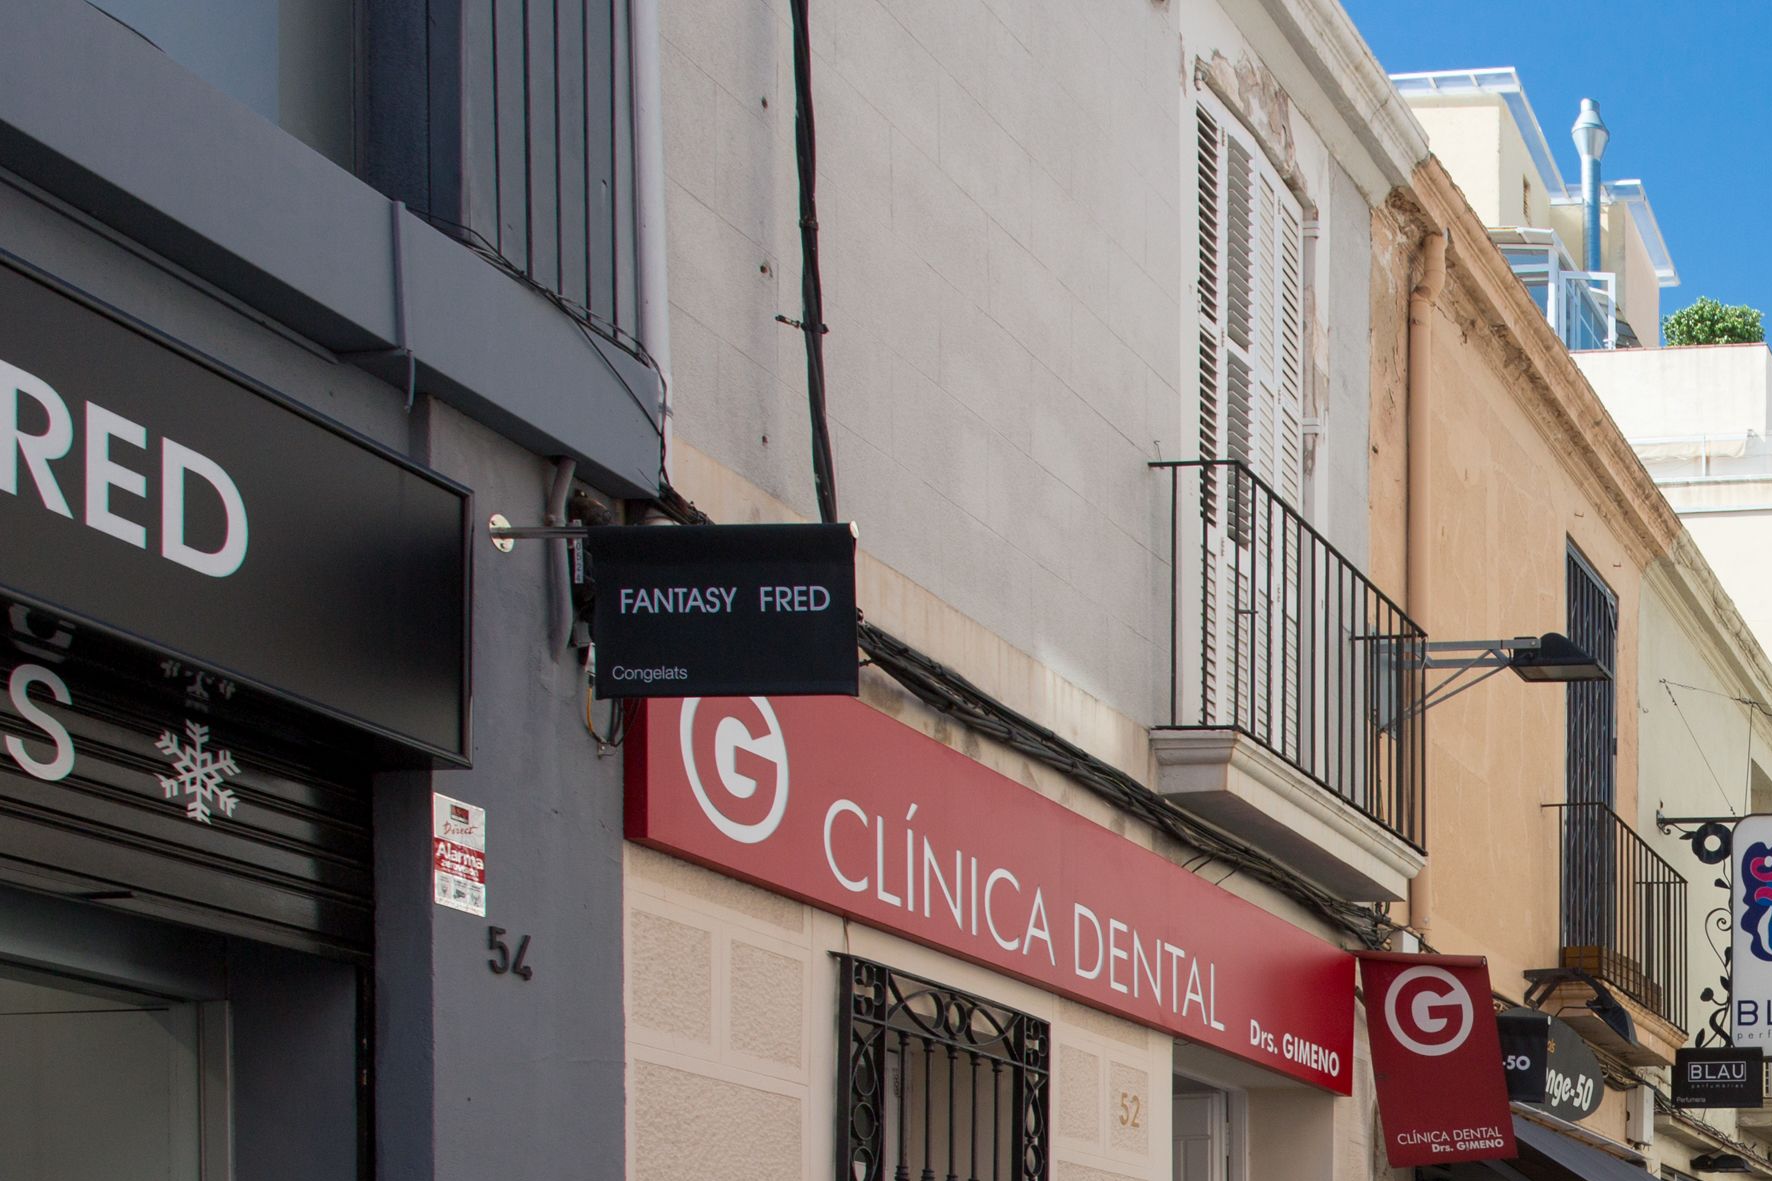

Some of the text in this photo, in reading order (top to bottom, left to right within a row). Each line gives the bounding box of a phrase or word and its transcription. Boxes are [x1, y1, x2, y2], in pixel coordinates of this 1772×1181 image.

[620, 586, 831, 614] FANTASY FRED
[612, 665, 688, 683] Congelats
[436, 841, 484, 870] Alarma
[823, 799, 1226, 1032] CLÍNICA DENTAL
[487, 925, 533, 981] 54
[1250, 1018, 1340, 1078] Drs. GIMENO
[1691, 1064, 1744, 1079] BLAU
[1545, 1067, 1594, 1111] nge-50
[1118, 1091, 1141, 1129] 52
[1397, 1126, 1502, 1145] CLÍNICA DENTAL
[1432, 1138, 1504, 1153] Drs. GIMENO
